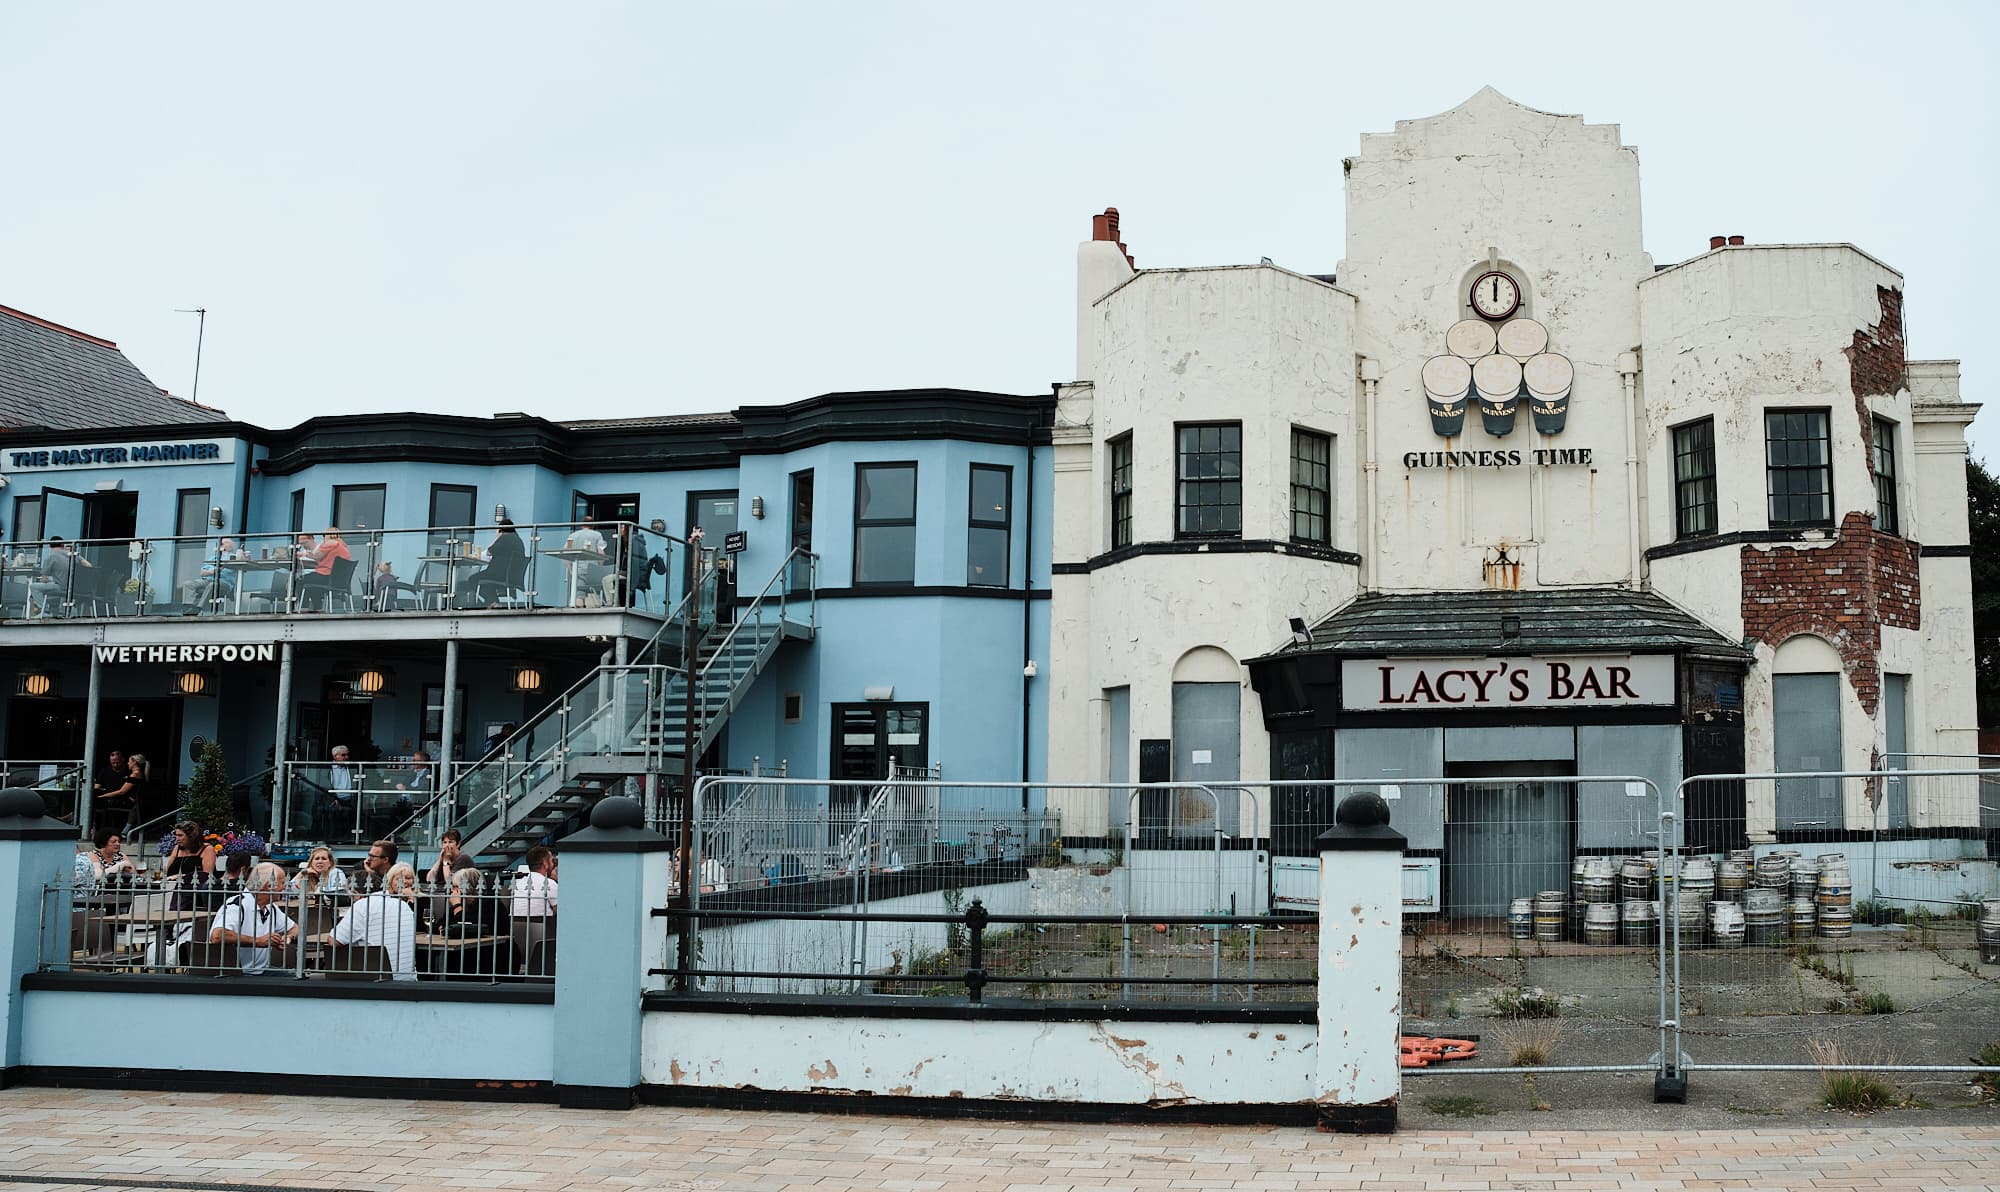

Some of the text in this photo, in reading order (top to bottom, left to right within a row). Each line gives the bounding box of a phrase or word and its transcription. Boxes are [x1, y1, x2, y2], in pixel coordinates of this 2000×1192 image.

[1431, 407, 1464, 417] GUINNESS
[1482, 406, 1515, 416] GUINNESS
[1533, 405, 1566, 415] GUINNESS
[10, 443, 220, 468] THE MASTER MARINER
[1403, 448, 1592, 468] GUINNESS TIME
[96, 645, 273, 663] WETHERSPOON
[1378, 662, 1639, 704] LACY'S BAR
